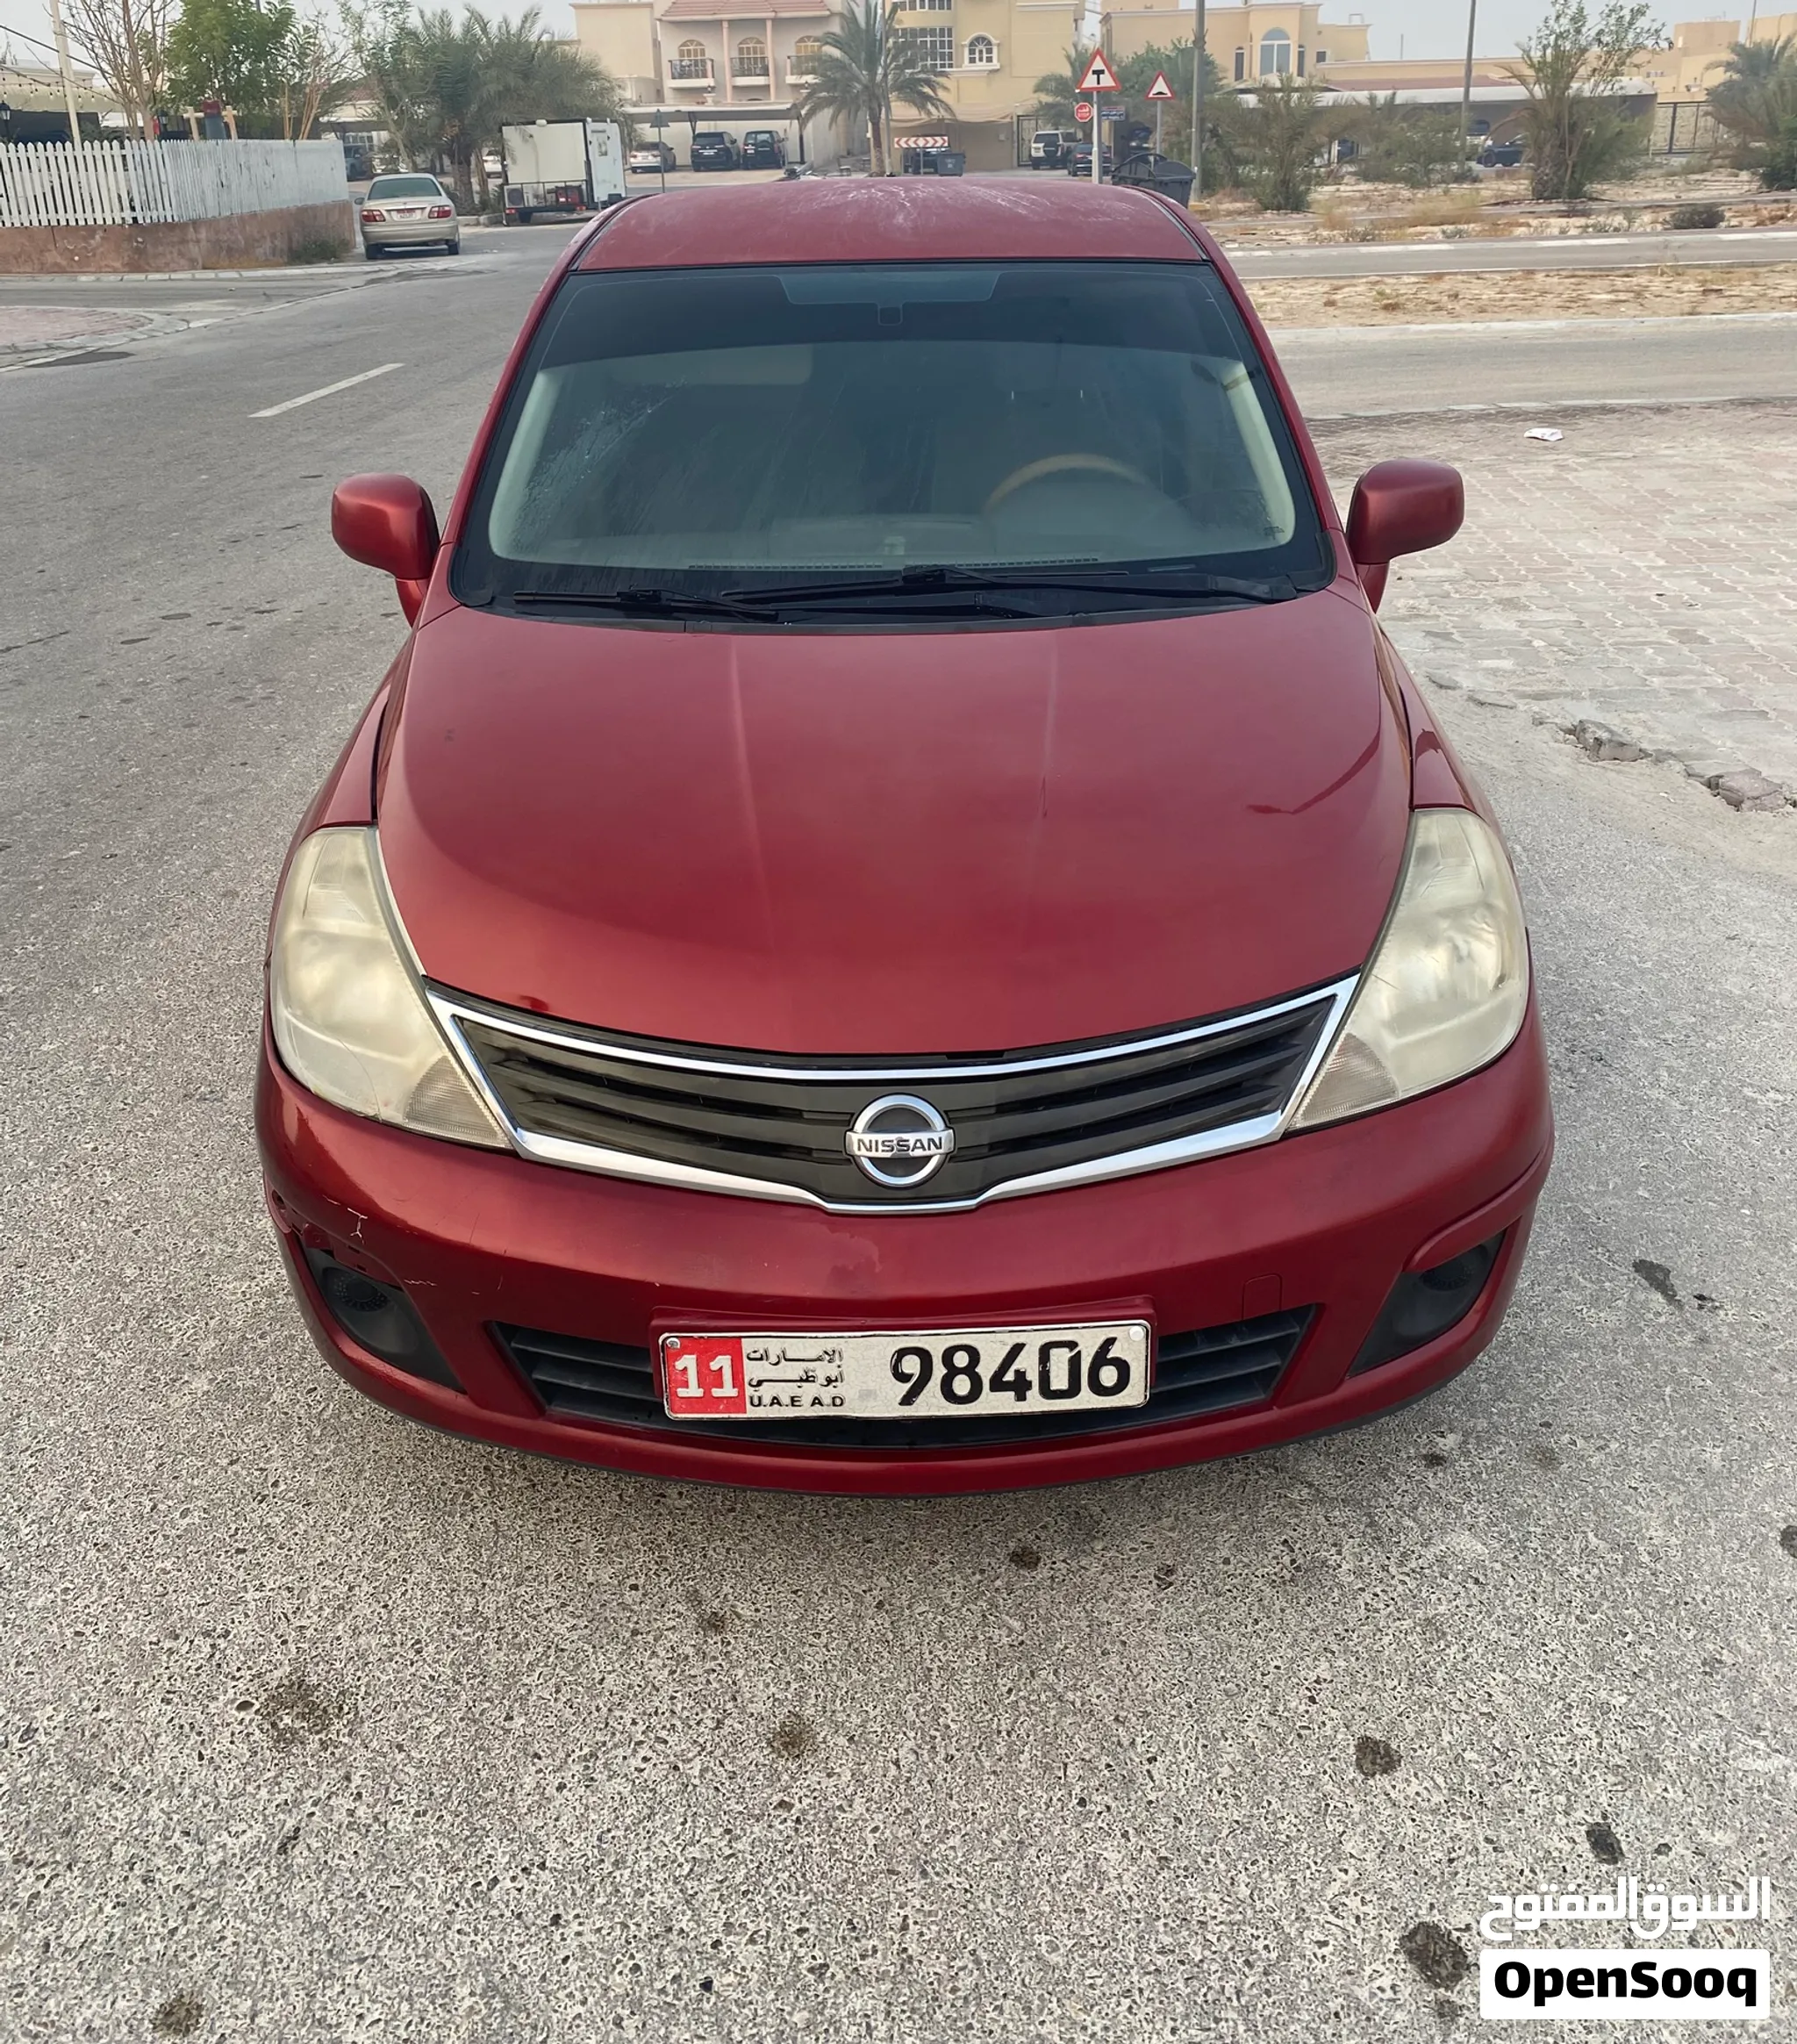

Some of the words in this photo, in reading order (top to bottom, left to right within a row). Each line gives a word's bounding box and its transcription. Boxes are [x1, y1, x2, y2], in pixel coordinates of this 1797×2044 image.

[856, 1136, 942, 1153] NISSAN
[673, 1352, 739, 1399] 11
[890, 1336, 1132, 1408] 98406
